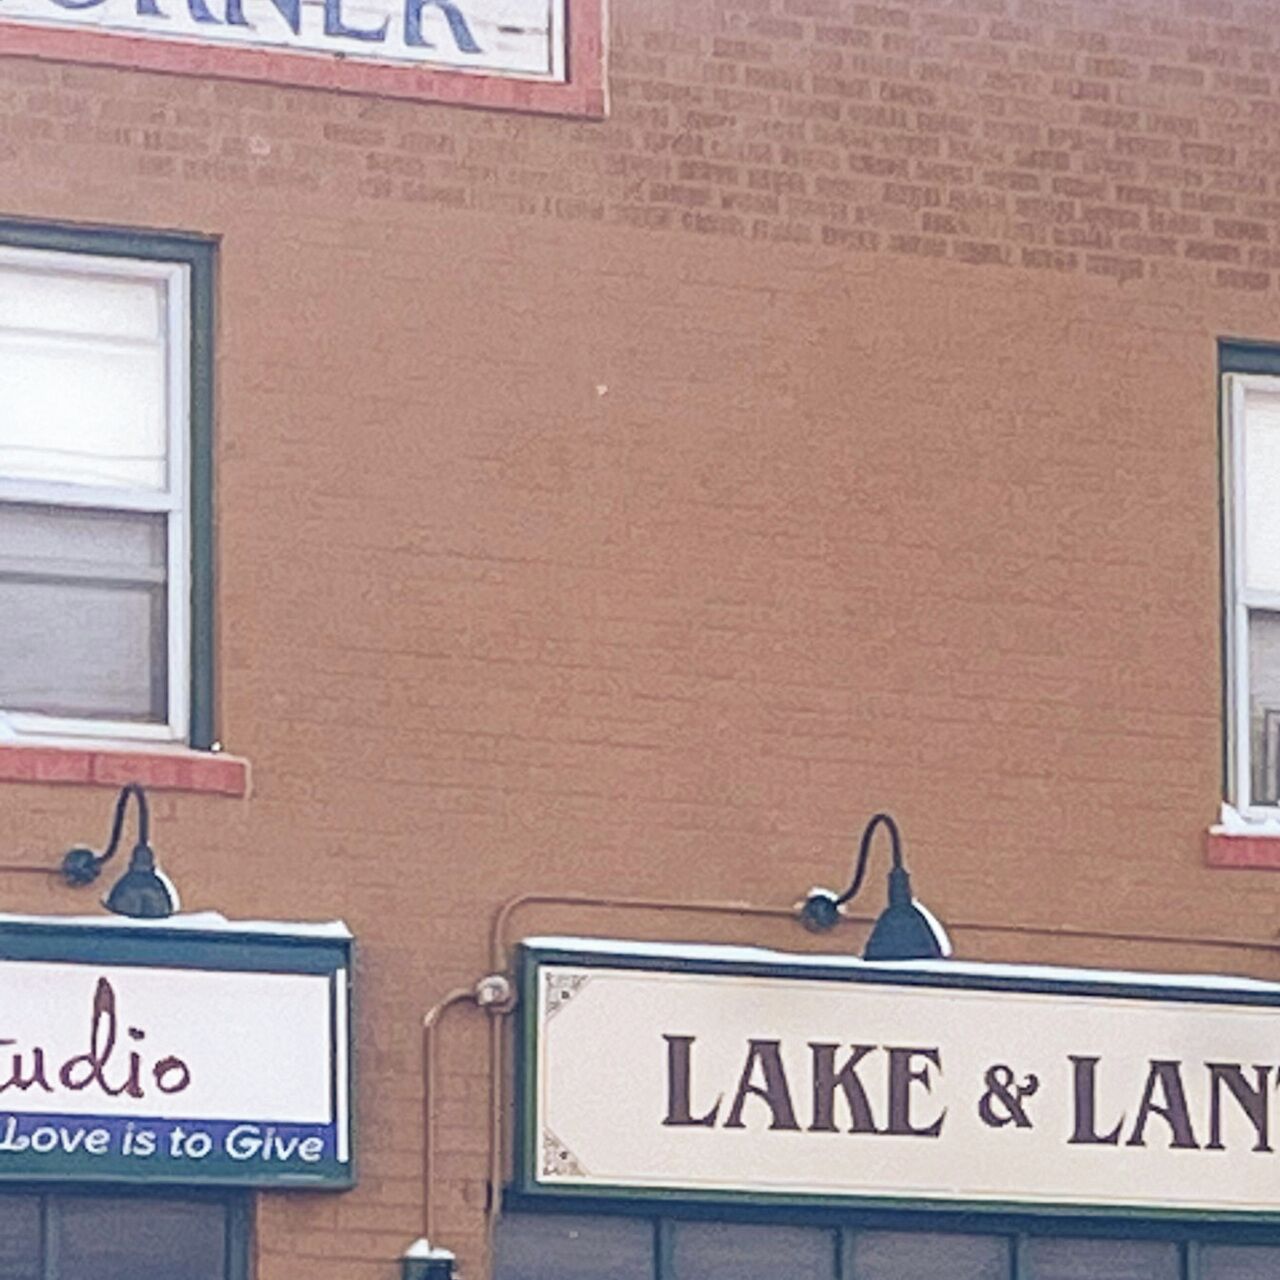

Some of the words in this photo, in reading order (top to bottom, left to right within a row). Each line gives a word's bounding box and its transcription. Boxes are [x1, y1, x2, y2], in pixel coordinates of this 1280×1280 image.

[0, 976, 191, 1098] udio
[660, 1033, 948, 1139] LAKE
[977, 1064, 1040, 1129] &
[0, 1115, 109, 1154] Love
[122, 1121, 156, 1156] is
[169, 1126, 212, 1158] to
[225, 1126, 325, 1161] Give
